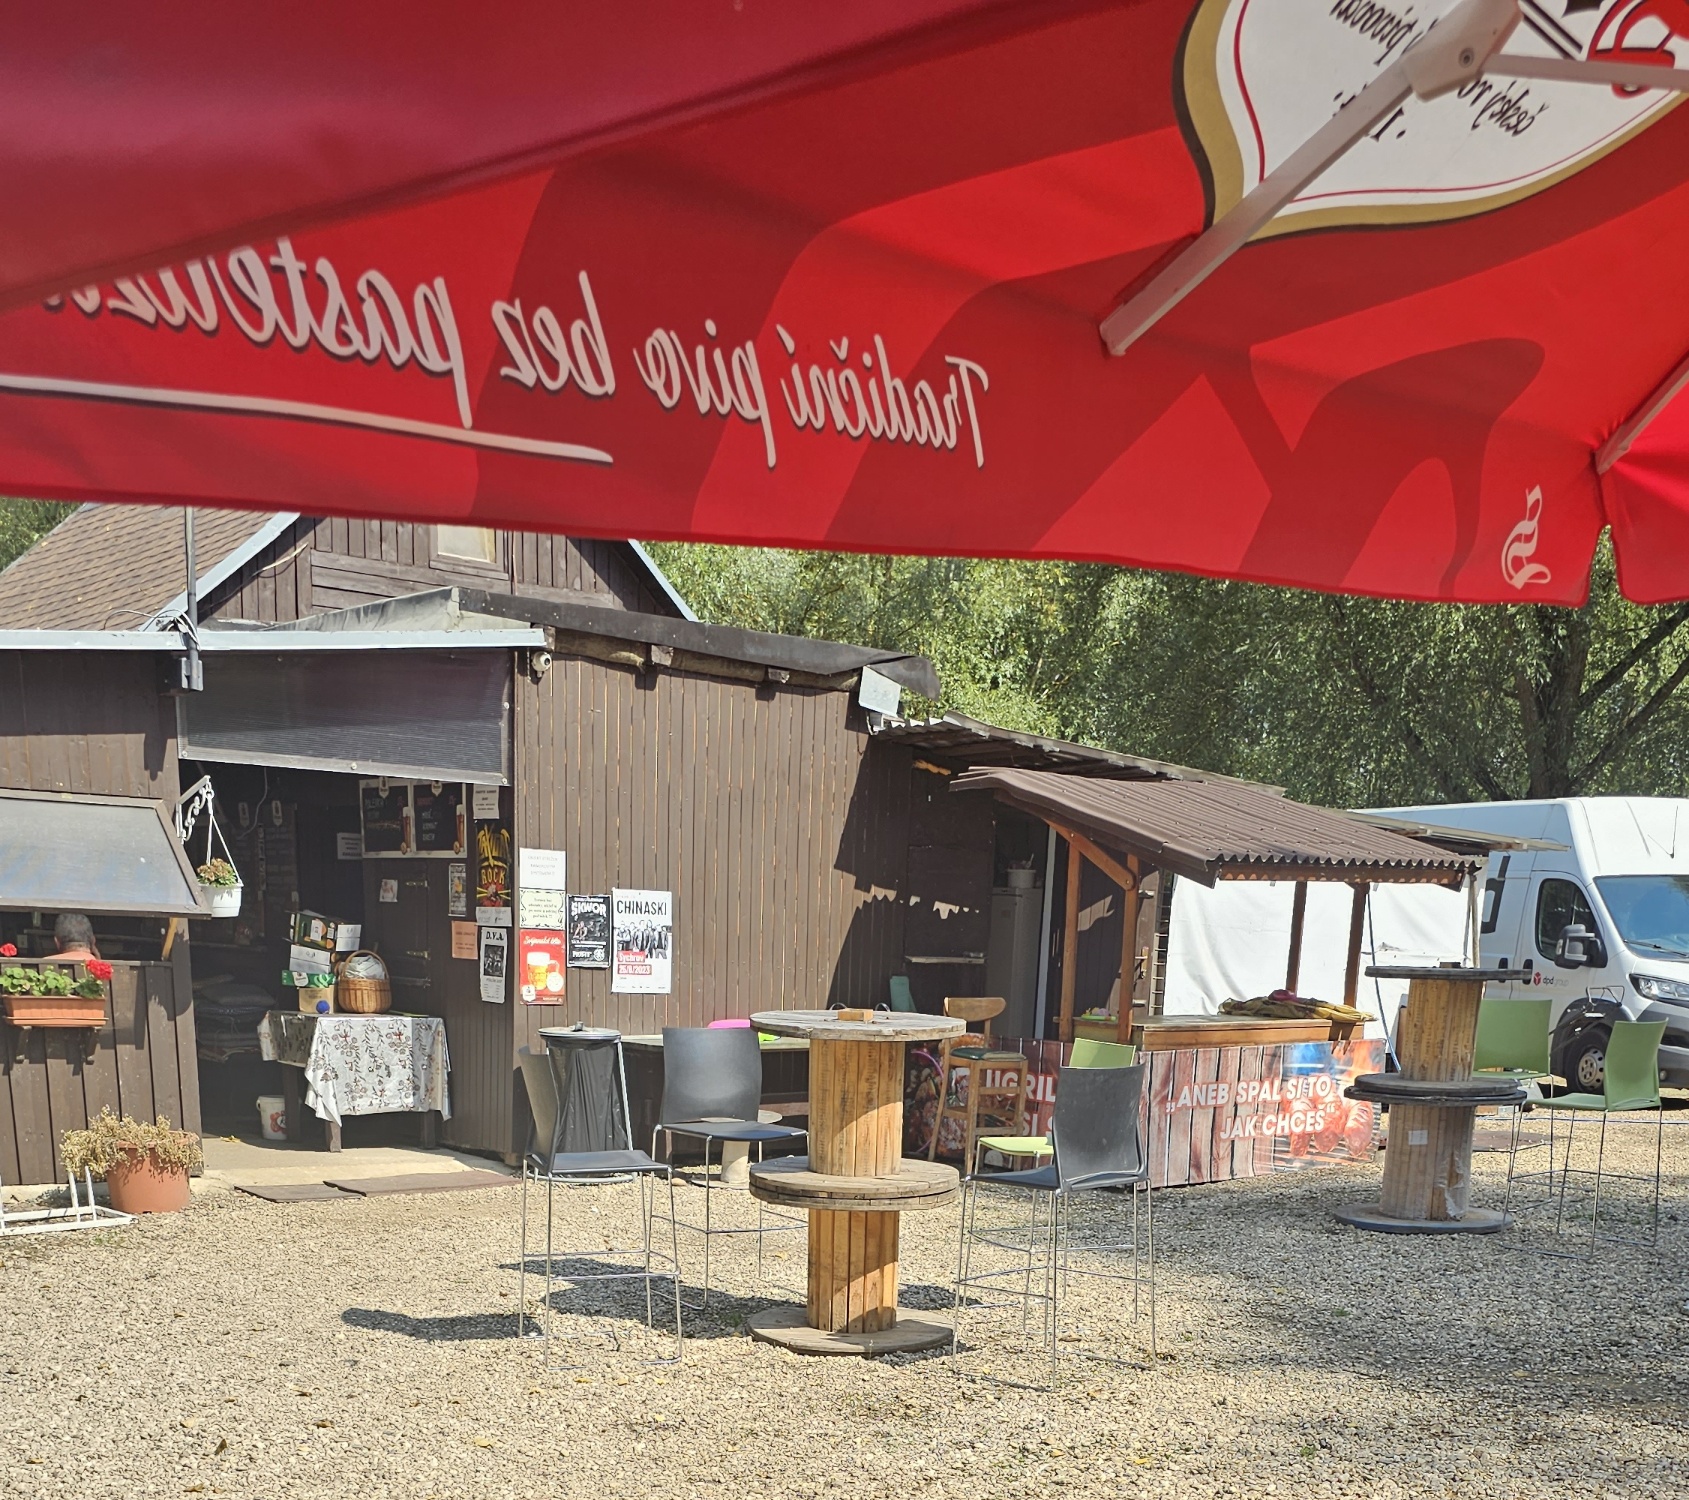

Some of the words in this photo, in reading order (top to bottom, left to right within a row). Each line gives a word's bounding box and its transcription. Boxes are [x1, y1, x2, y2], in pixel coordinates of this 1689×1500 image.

[481, 868, 506, 884] ROCK
[616, 900, 667, 915] CHINASKI
[1236, 1079, 1281, 1104] SPAL
[1287, 1077, 1303, 1100] SI
[1307, 1075, 1332, 1098] TO
[1220, 1115, 1259, 1139] JAK
